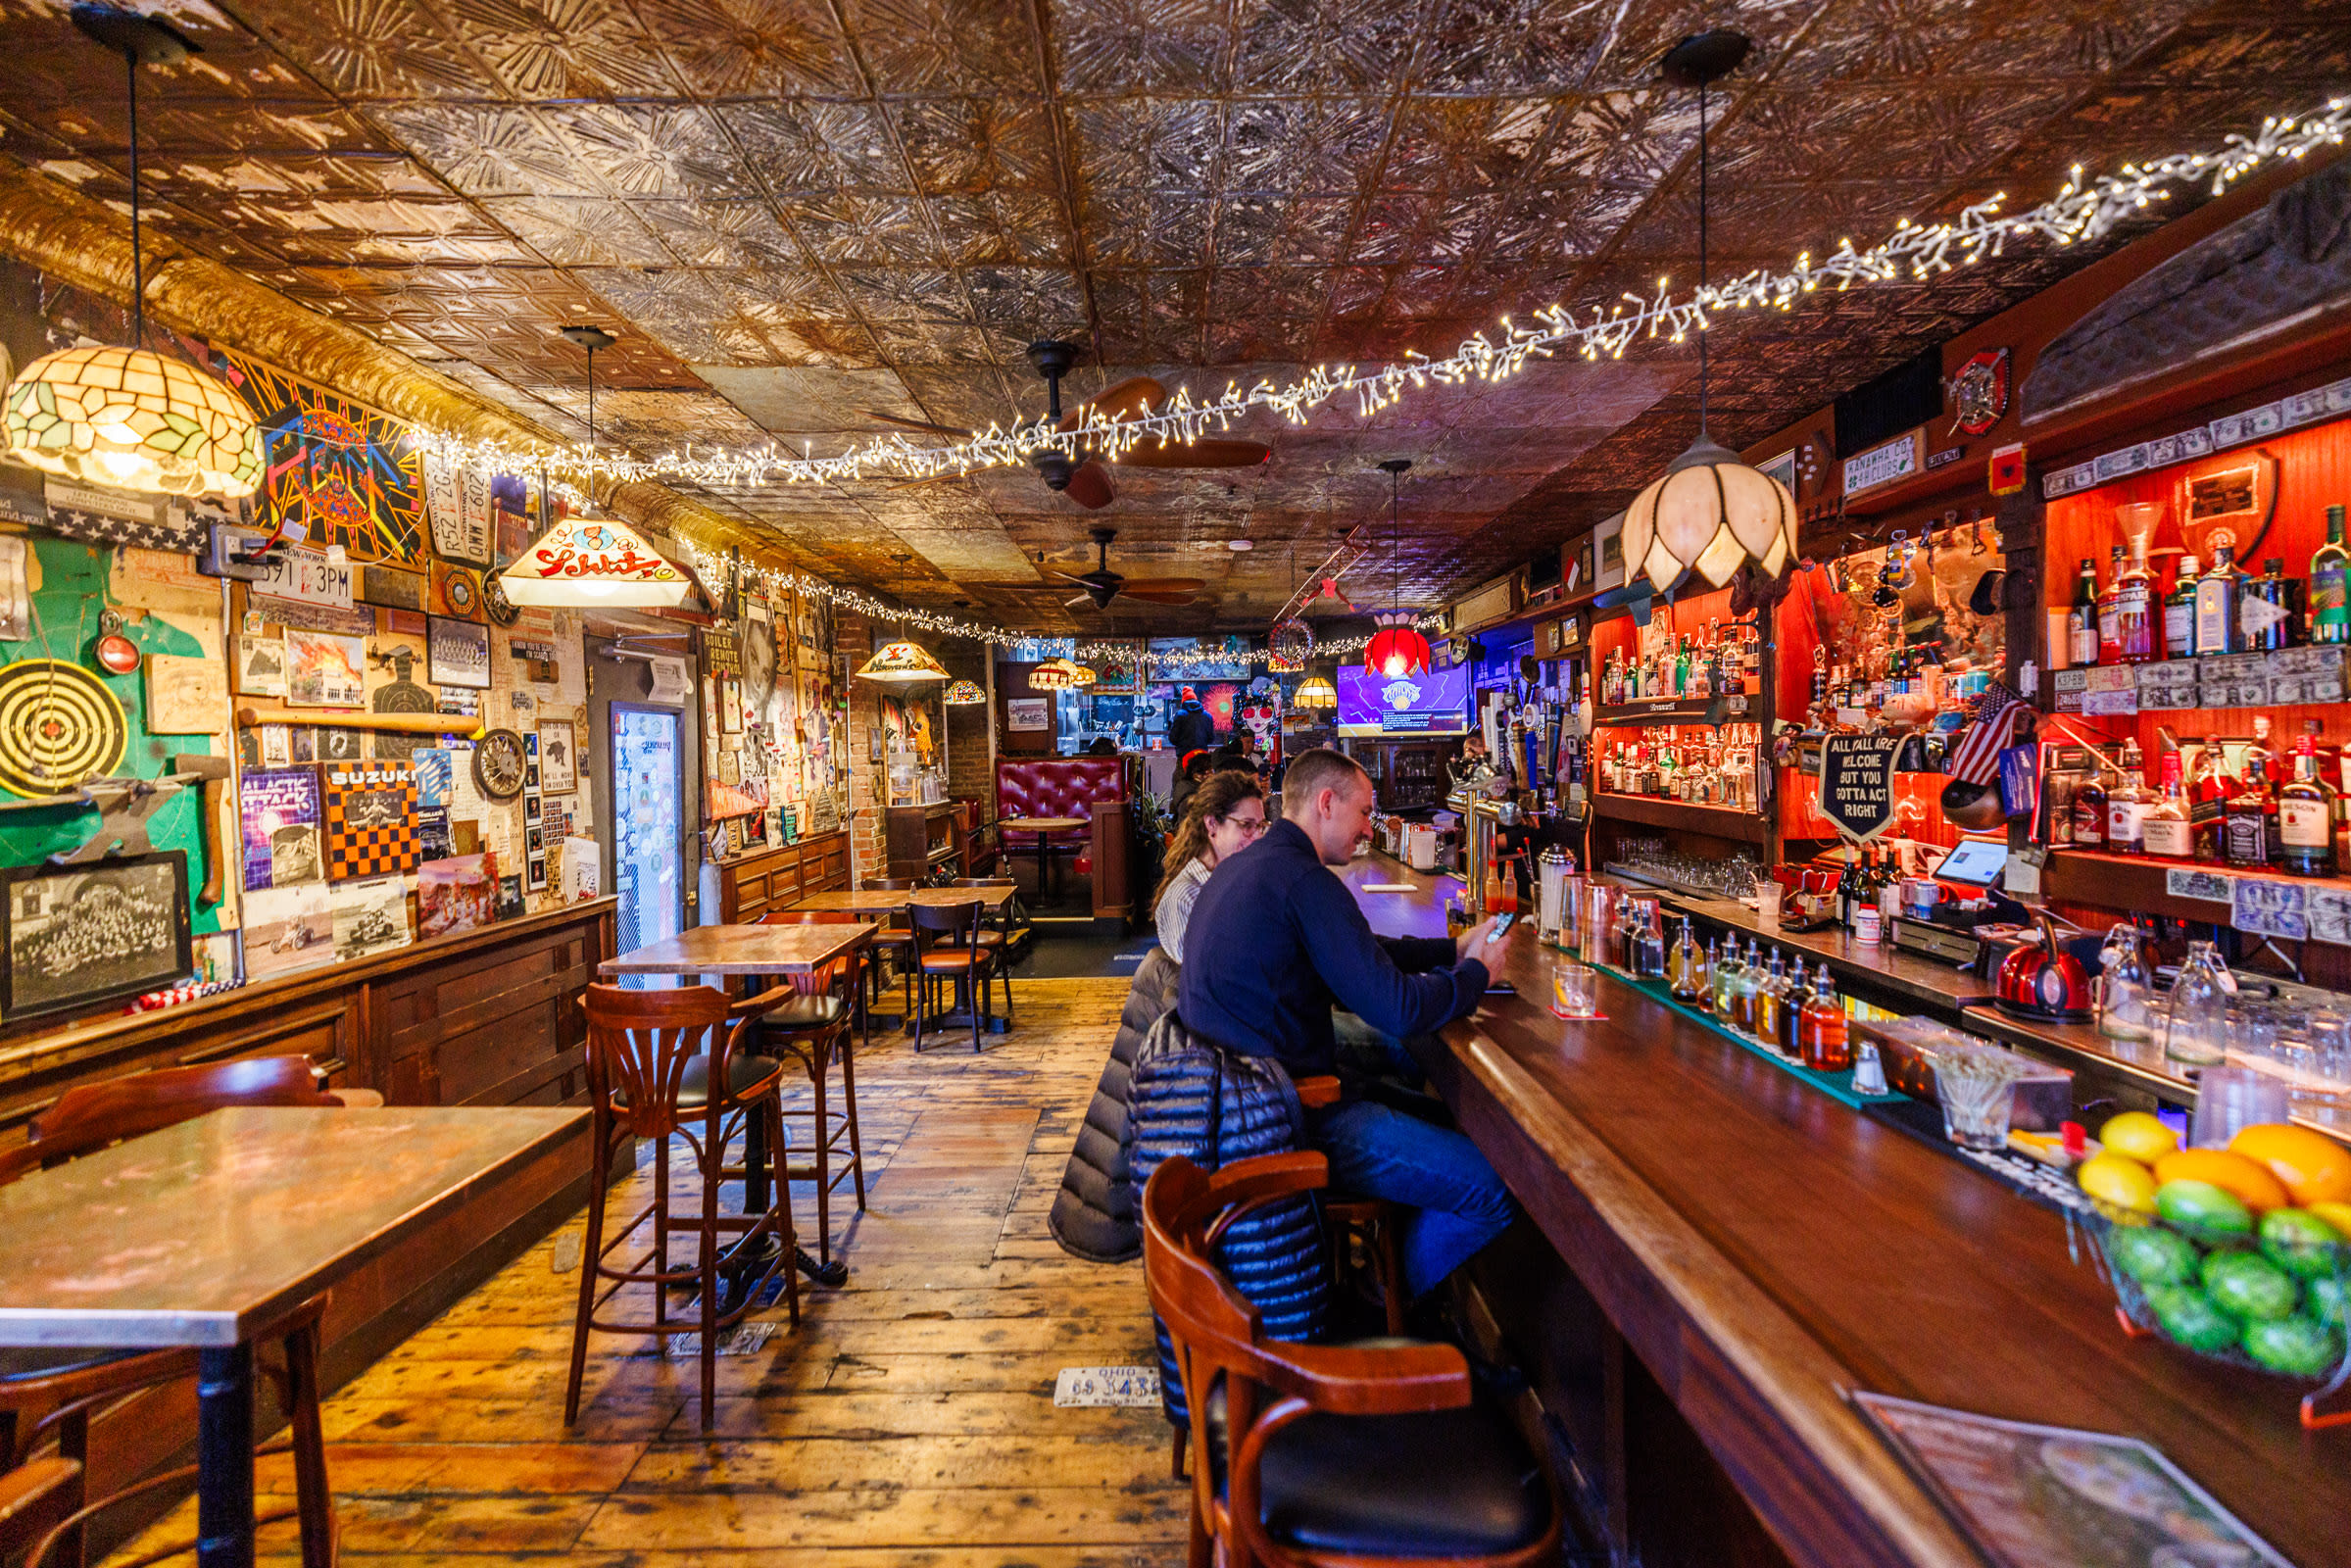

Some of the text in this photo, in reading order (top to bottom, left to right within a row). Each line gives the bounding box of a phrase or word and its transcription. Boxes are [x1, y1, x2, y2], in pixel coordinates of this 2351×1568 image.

[1848, 441, 1907, 472] KANAWHA CO
[1872, 459, 1898, 482] CLUBS
[468, 473, 485, 508] 602
[439, 517, 461, 552] R52
[280, 548, 327, 564] NEW YORK
[316, 564, 349, 598] 3PM
[2119, 590, 2150, 602] MPARI
[705, 634, 733, 649] BOILER
[710, 647, 739, 663] REMOTE
[711, 661, 743, 675] CONTROL
[1385, 685, 1419, 700] KNICKS
[1831, 739, 1851, 753] ALL
[1874, 736, 1898, 752] ARE
[330, 769, 416, 785] SUZUKI
[1839, 771, 1882, 785] BUT YOU
[241, 777, 310, 795] ALACTIC
[1836, 788, 1887, 802] GOTTA ACT
[1844, 804, 1878, 818] RIGHT
[1099, 1367, 1136, 1379] OHIO
